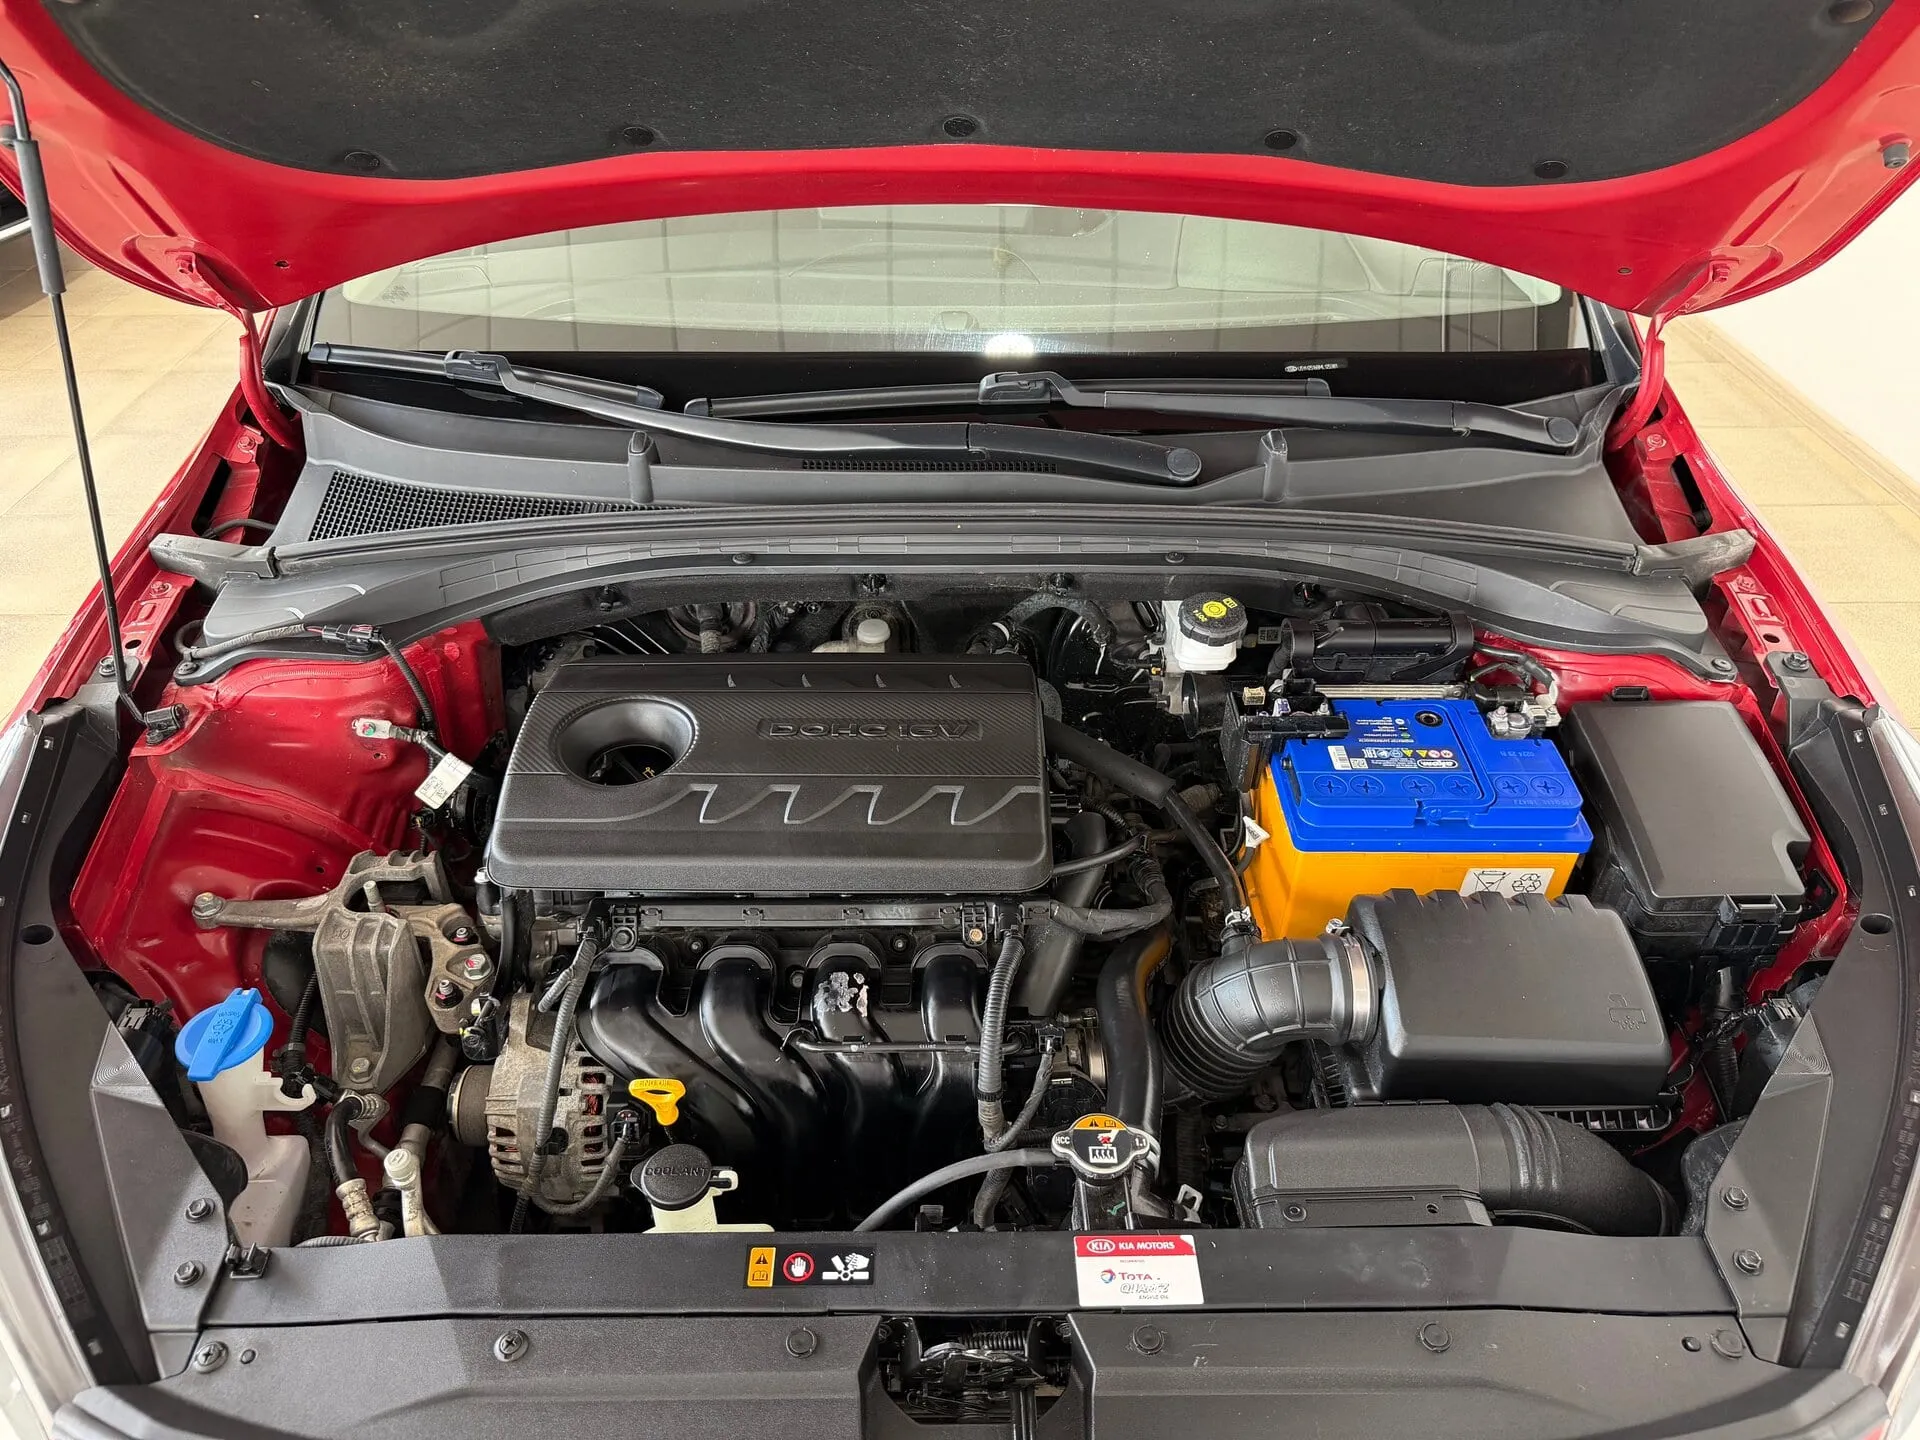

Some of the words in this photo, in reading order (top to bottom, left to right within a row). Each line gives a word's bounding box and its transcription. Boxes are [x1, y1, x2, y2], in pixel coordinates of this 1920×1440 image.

[769, 722, 888, 738] DOHC
[899, 723, 969, 739] 16V
[1055, 1136, 1071, 1145] HCC
[1134, 1137, 1147, 1147] 1.1
[645, 1166, 709, 1177] COOLANT
[1090, 1240, 1112, 1251] KIA
[1119, 1242, 1135, 1250] KIA
[1136, 1241, 1176, 1250] MOTORS
[1118, 1271, 1161, 1281] TOTA
